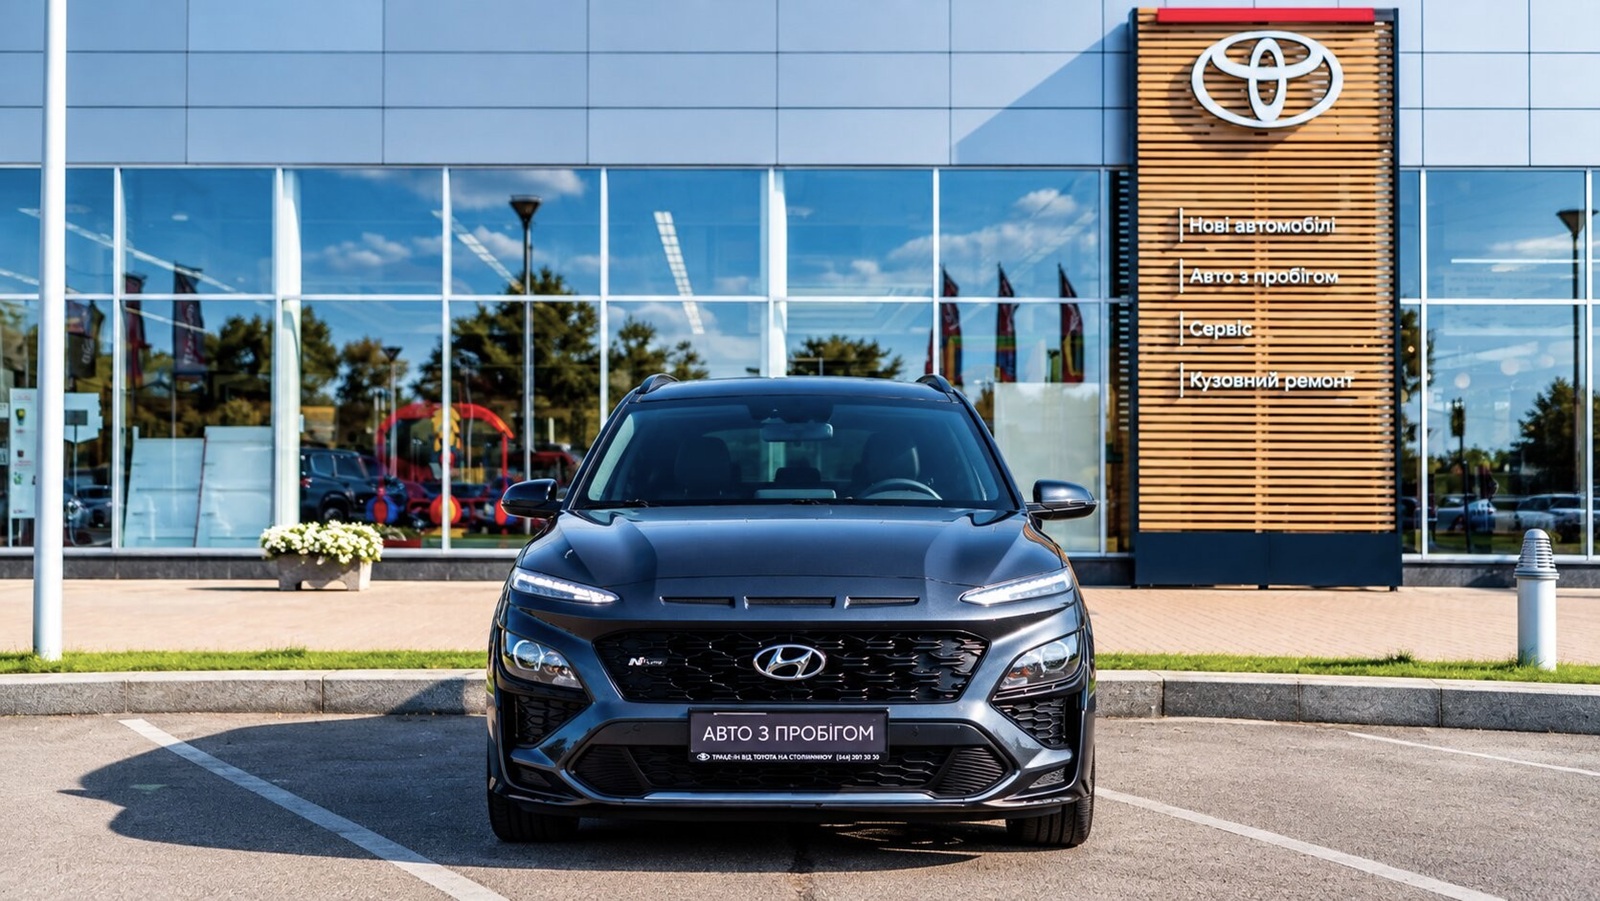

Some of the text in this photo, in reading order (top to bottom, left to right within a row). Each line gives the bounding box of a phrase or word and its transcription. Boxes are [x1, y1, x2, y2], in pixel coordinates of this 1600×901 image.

[1190, 217, 1335, 232] Нові автомобілі
[1190, 268, 1339, 287] Авто з пробігом
[1190, 320, 1252, 339] Сервіс
[1191, 372, 1354, 391] Кузовний ремонт
[703, 726, 752, 741] АВТО
[776, 724, 873, 741] ПРОБІГОМ
